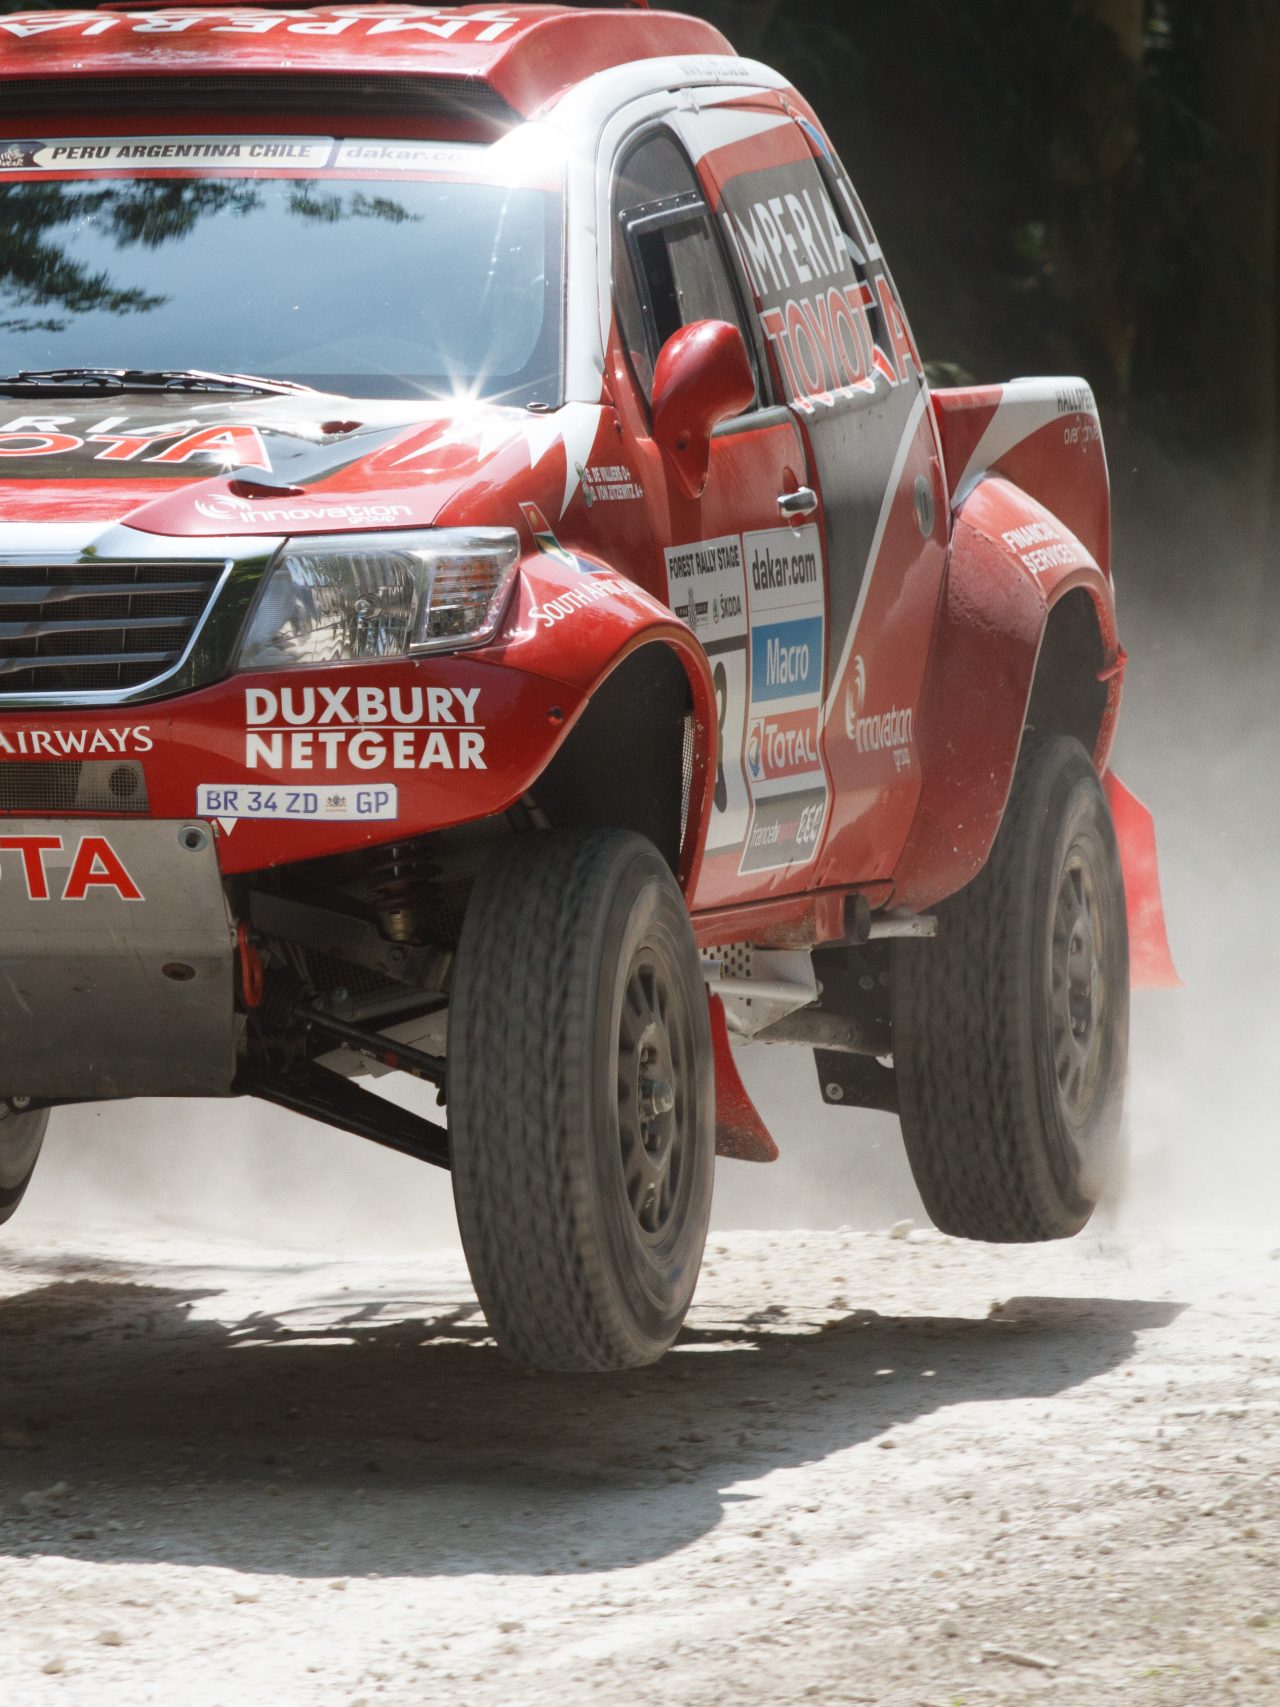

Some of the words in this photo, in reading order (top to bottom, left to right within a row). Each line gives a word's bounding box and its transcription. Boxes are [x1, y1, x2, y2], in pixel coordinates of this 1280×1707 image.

[51, 145, 111, 160] PERU
[116, 144, 241, 159] ARGENTINA
[248, 143, 313, 158] CHILE
[345, 146, 475, 161] dakar.co
[723, 177, 883, 297] IMPERIAL
[759, 273, 926, 413] TOYOTA
[239, 504, 413, 523] innovation
[348, 514, 397, 525] group
[668, 553, 694, 580] FOREST
[695, 549, 717, 575] RALLY
[717, 544, 740, 569] STAGE
[751, 548, 817, 591] dakar.com
[528, 585, 591, 628] SOUTH
[720, 593, 742, 620] ŠKODA
[766, 637, 810, 686] Macro
[244, 686, 482, 725] DUXBURY
[766, 723, 817, 769] TOTAL
[855, 704, 913, 753] innovation
[245, 731, 488, 770] NETGEAR
[205, 790, 239, 812] BR
[246, 790, 278, 813] 34
[285, 791, 318, 814] ZD
[355, 791, 389, 814] GP
